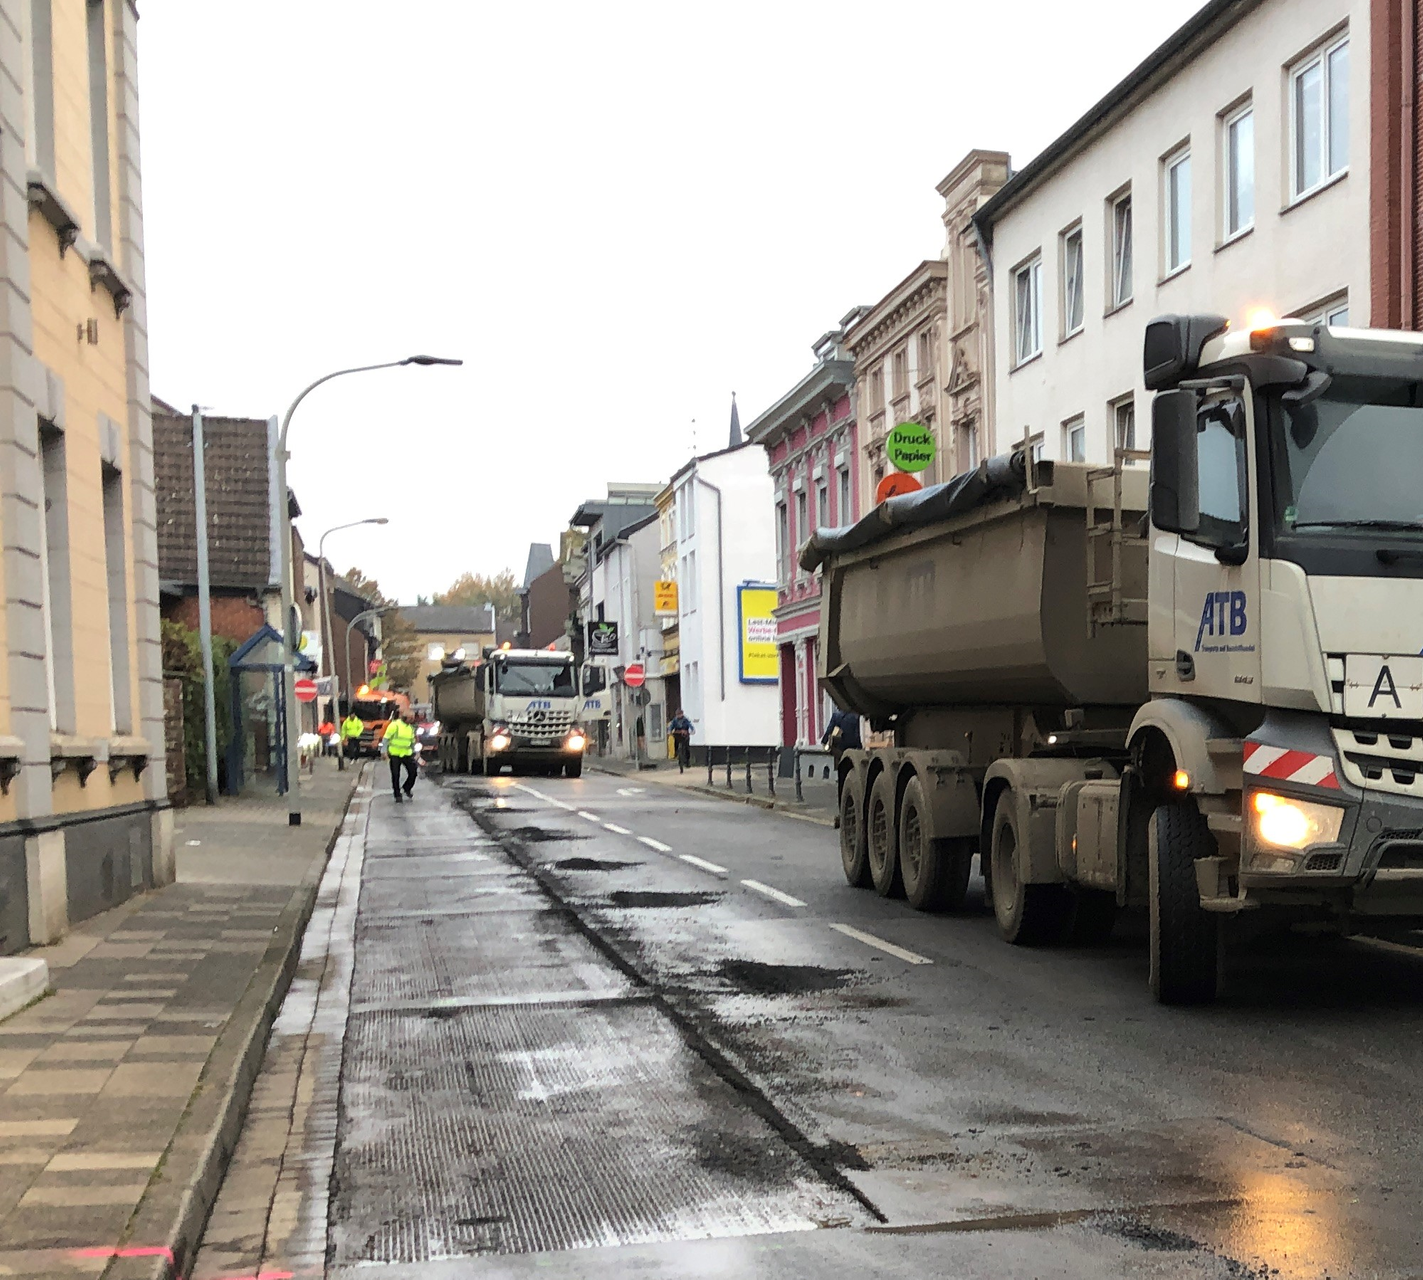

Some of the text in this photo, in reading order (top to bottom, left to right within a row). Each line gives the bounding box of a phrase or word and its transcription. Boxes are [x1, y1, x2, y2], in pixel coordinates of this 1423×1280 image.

[893, 432, 931, 445] Druck
[894, 448, 932, 463] Papier
[1195, 591, 1248, 652] ATB
[1367, 665, 1402, 709] A
[525, 701, 552, 712] ATB
[582, 700, 602, 713] ATB
